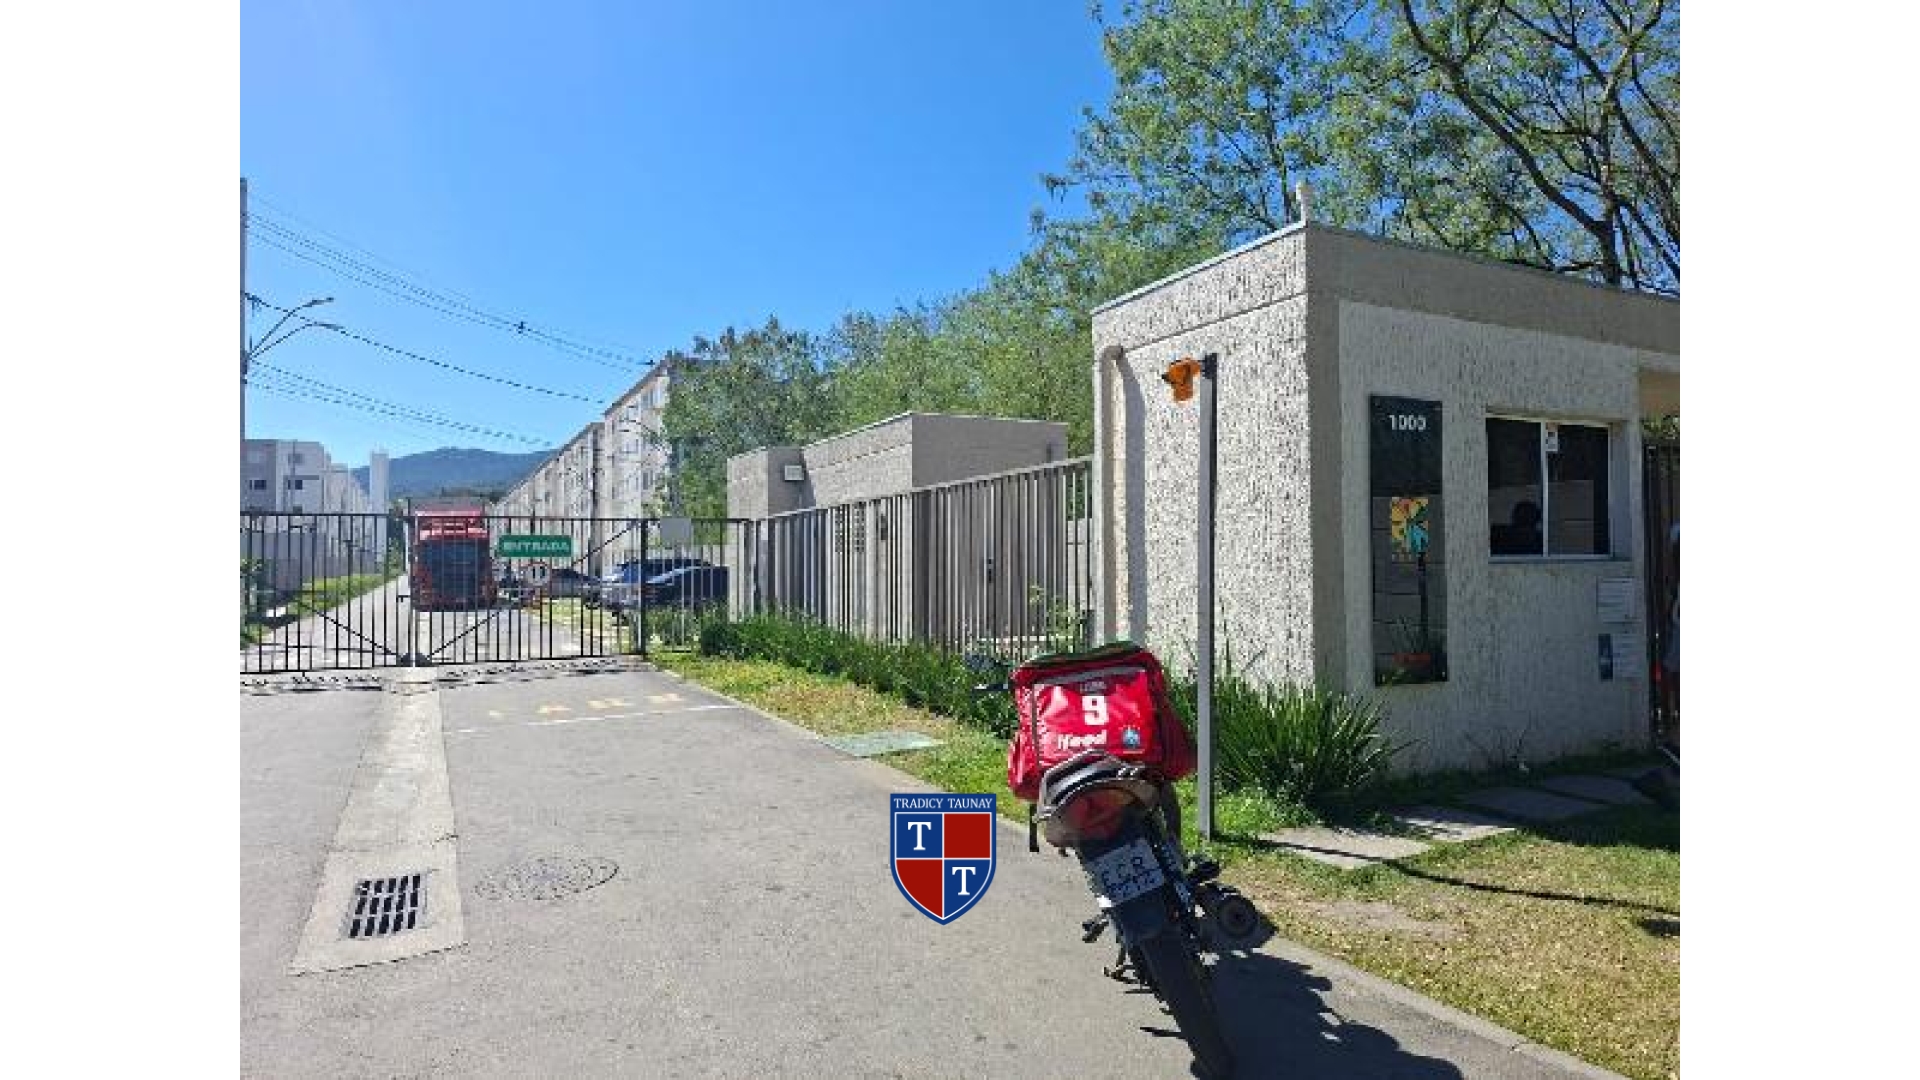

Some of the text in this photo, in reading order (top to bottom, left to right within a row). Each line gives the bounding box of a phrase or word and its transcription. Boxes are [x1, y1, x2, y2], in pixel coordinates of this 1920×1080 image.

[1389, 414, 1427, 432] 1000
[503, 541, 570, 554] ENTRADA
[1081, 695, 1110, 725] 9
